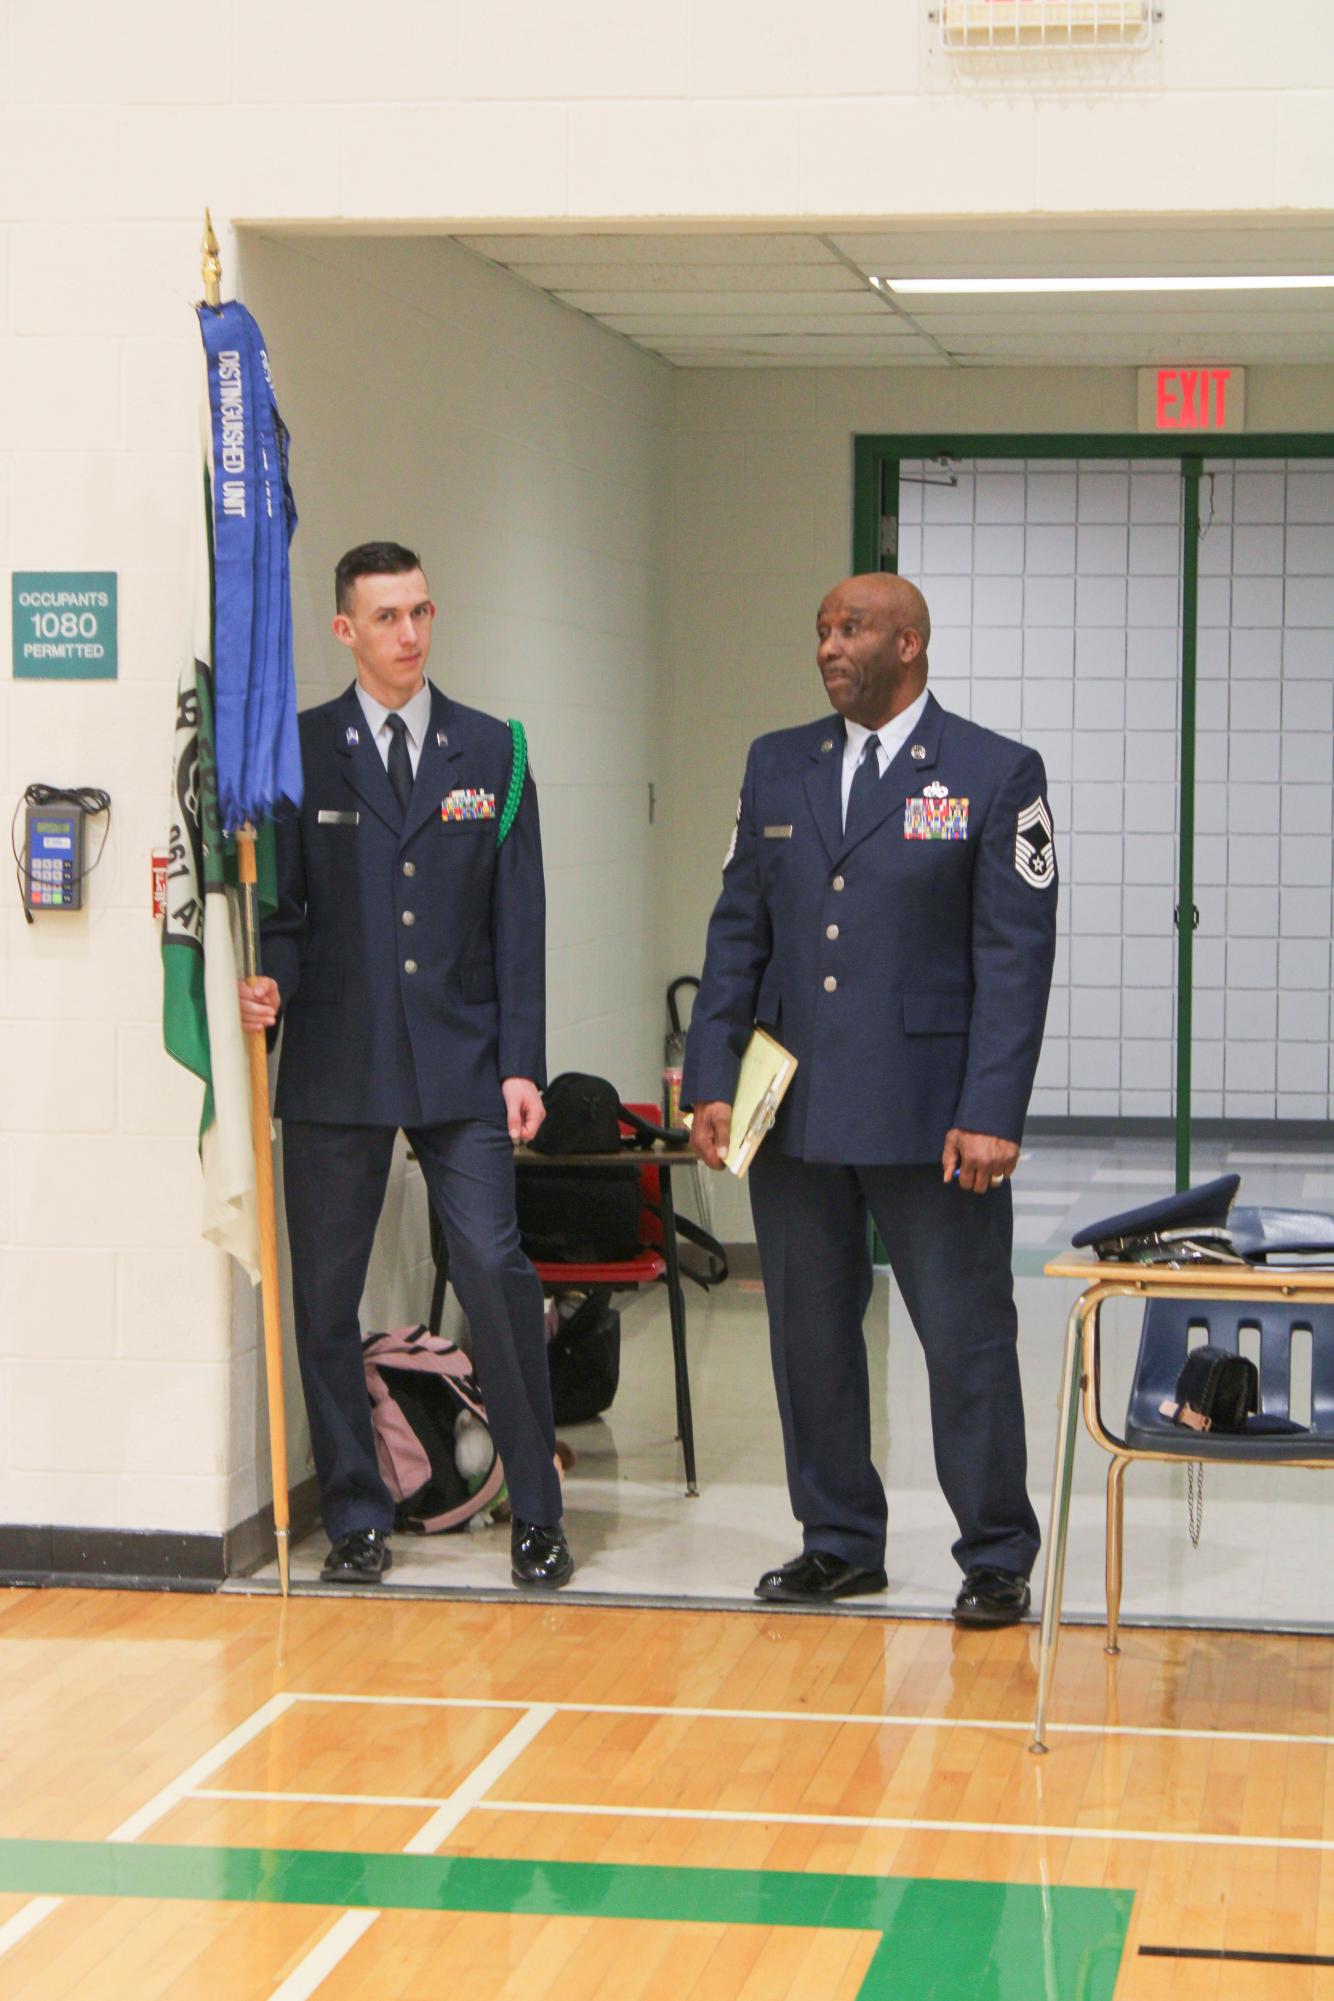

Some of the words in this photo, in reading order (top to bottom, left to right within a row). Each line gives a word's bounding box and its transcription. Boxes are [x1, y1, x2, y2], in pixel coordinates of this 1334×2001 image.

[218, 350, 245, 474] DISTINGUISHED
[1156, 368, 1231, 428] EXIT
[222, 480, 246, 518] UNIT
[19, 592, 109, 607] OCCUPANTS
[30, 612, 97, 638] 1080
[24, 643, 105, 658] PERMITTED
